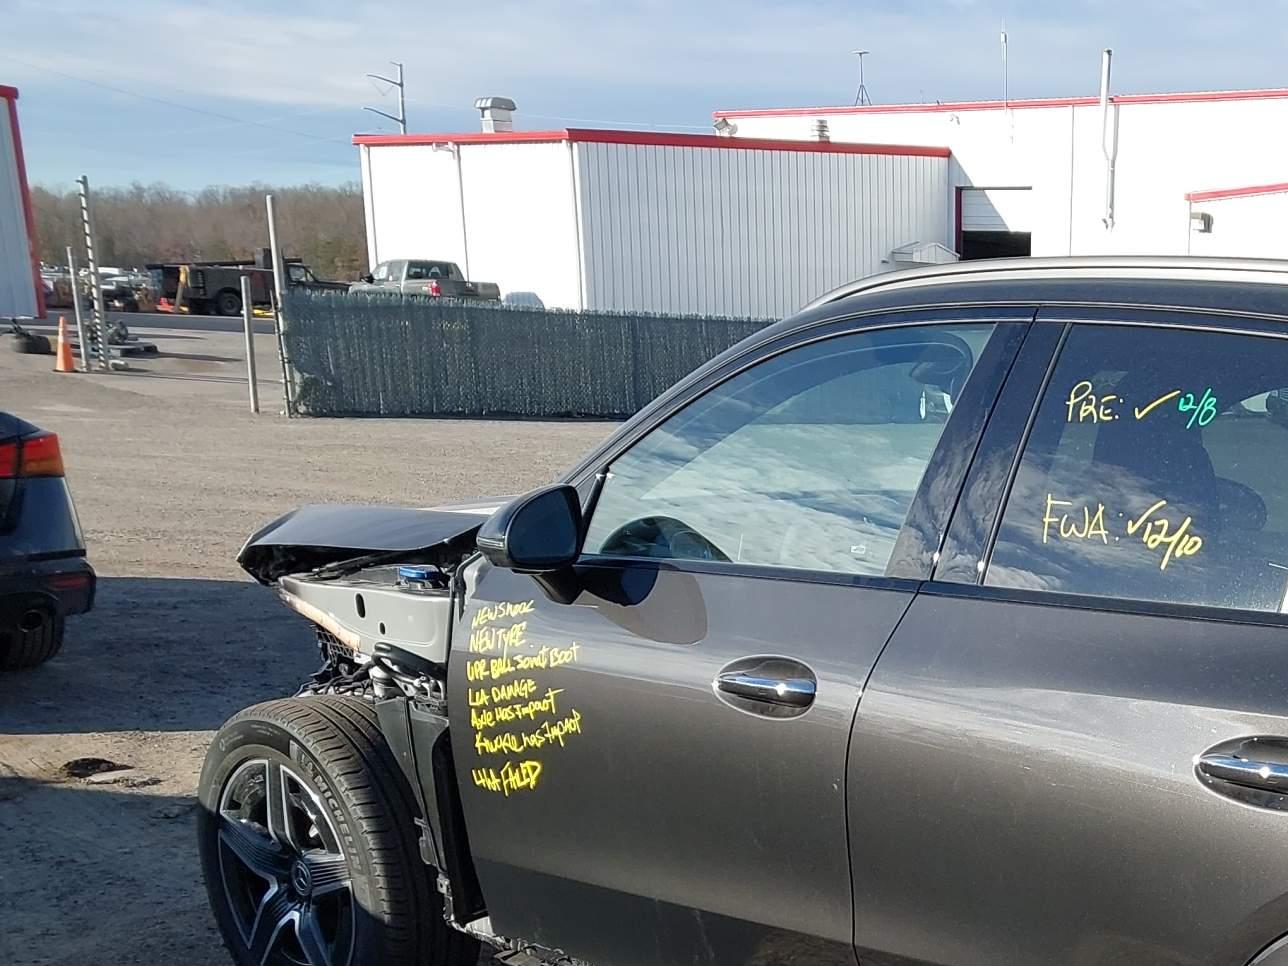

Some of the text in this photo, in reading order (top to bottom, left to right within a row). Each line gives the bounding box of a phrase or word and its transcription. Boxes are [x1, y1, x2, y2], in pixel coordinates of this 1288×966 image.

[1066, 381, 1124, 423] PRE:
[469, 626, 495, 653] NEW
[315, 777, 363, 874] MICHELIN
